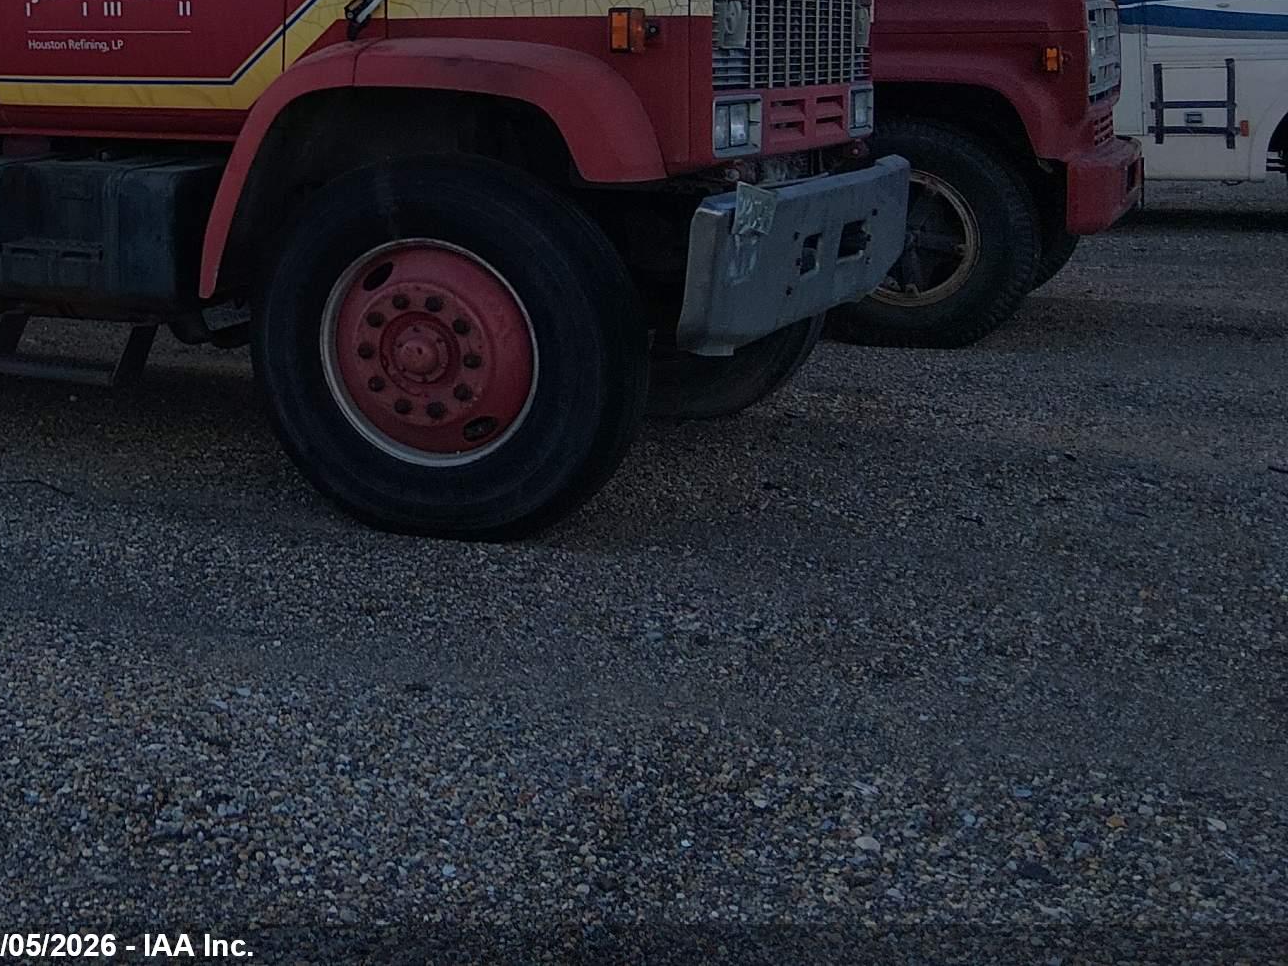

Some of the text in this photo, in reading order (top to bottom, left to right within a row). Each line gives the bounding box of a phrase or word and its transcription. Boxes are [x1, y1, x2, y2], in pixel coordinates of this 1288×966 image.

[28, 39, 124, 53] Houston Refining, LP
